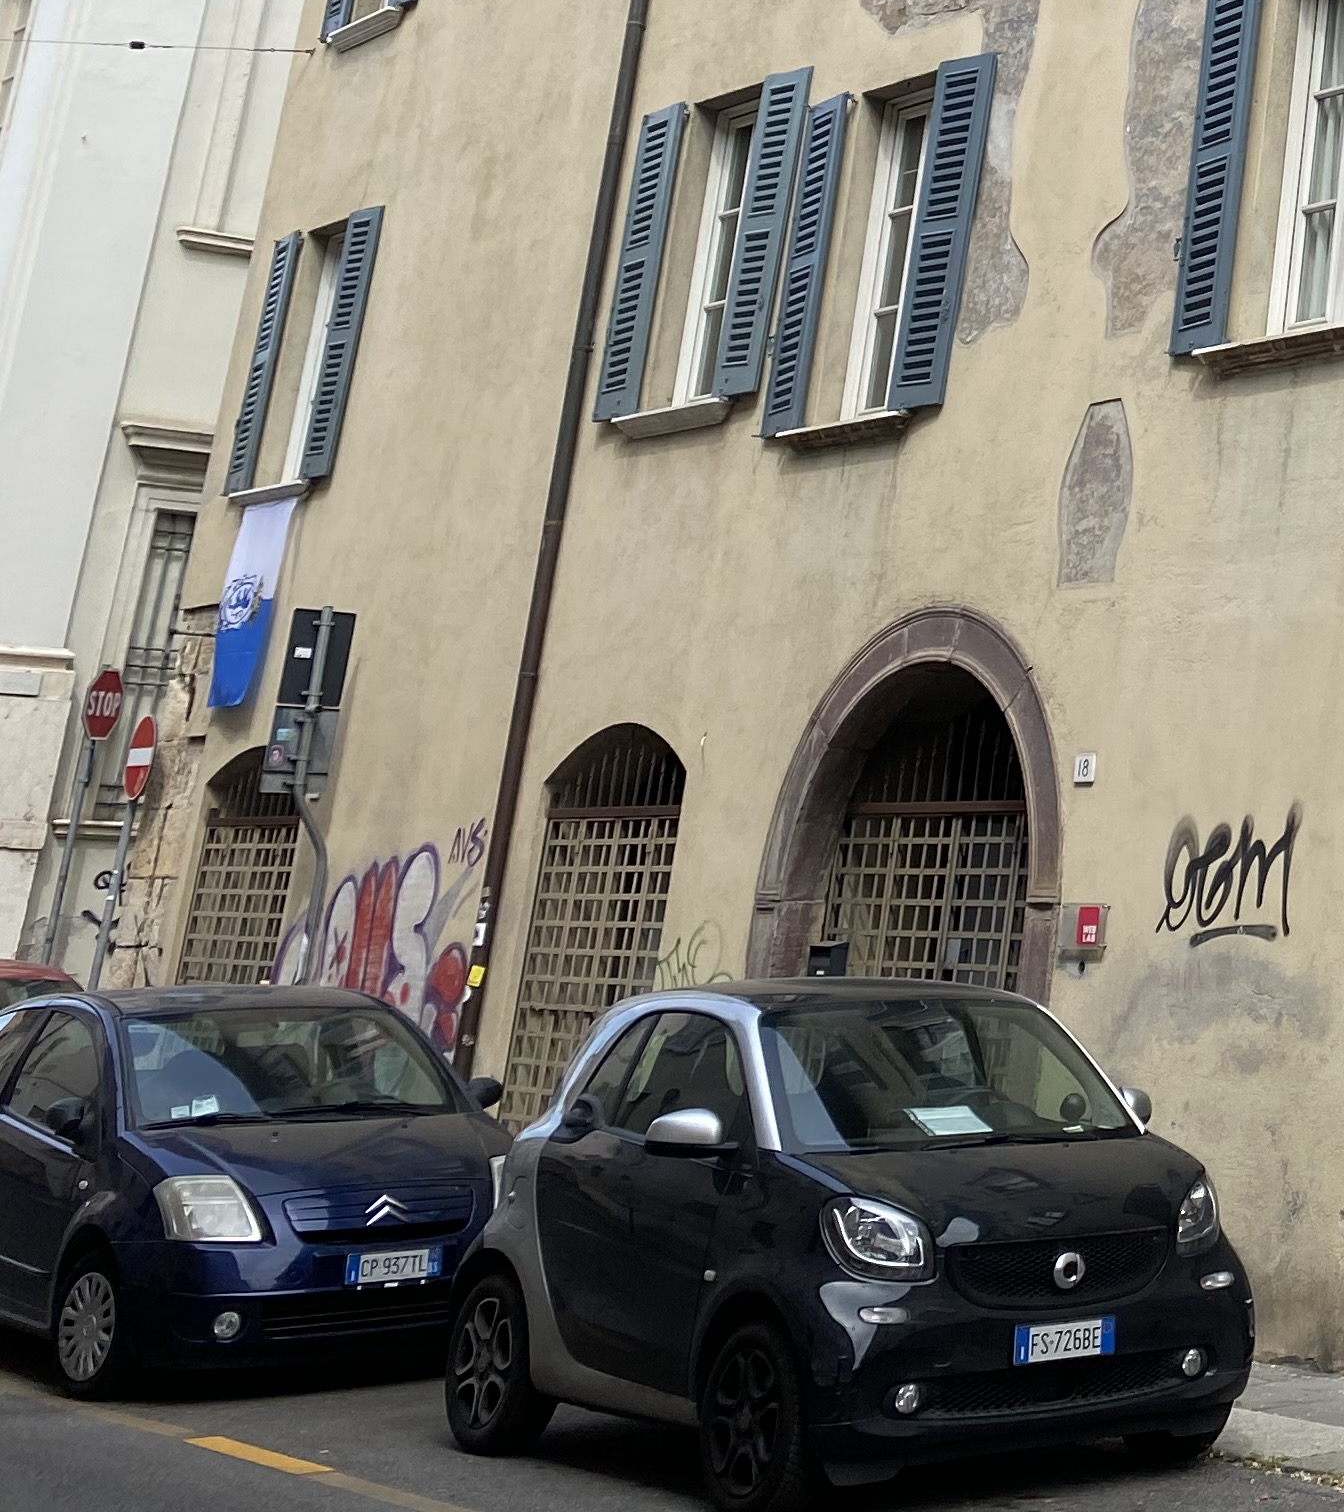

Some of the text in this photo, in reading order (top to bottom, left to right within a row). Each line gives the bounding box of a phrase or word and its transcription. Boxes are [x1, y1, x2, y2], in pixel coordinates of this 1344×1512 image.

[86, 691, 121, 717] STOP
[1078, 759, 1089, 777] 18
[1082, 934, 1095, 942] LAB
[361, 1258, 379, 1277] CP
[383, 1255, 427, 1276] 937TL
